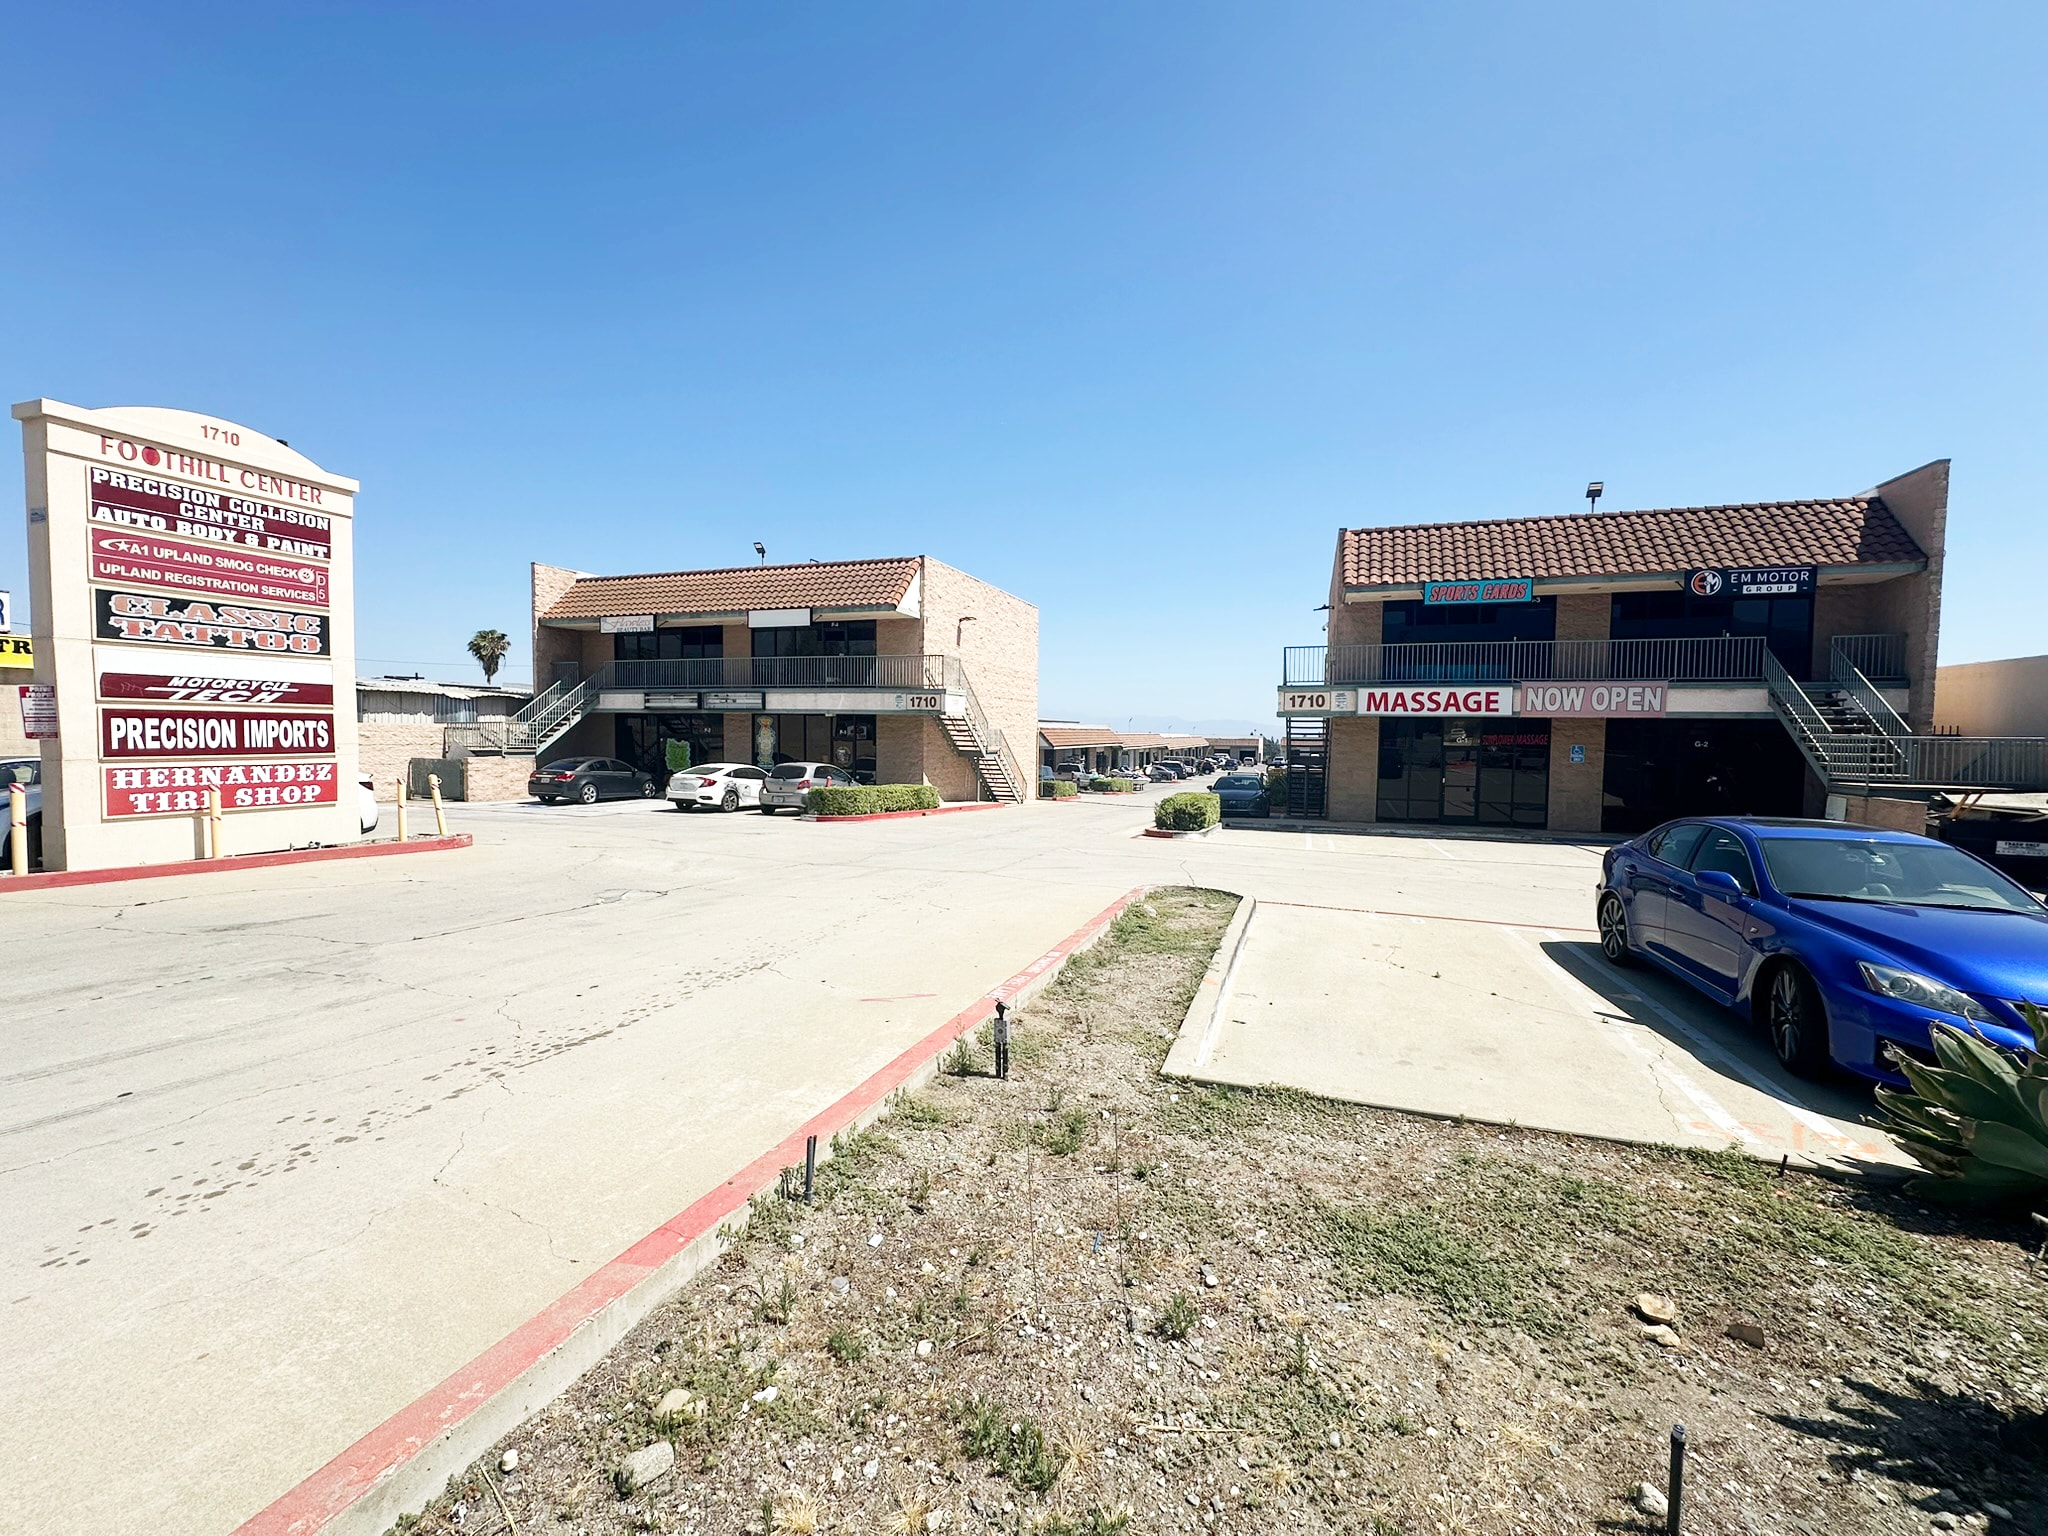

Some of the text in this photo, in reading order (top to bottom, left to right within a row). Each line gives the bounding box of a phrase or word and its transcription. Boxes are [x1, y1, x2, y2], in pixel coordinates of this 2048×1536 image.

[201, 425, 240, 446] 1710
[101, 435, 322, 504] FOOTHILL CENTER
[92, 468, 329, 531] PRECISION COLLISION
[180, 502, 264, 531] CENTER
[95, 505, 328, 558] AUTO BODY & PAINT
[129, 543, 298, 580] A1 UPLAND SMOG CHECK
[99, 562, 316, 601] UPLAND REGISTRATION SERVICES
[318, 575, 326, 586] D
[1731, 571, 1809, 583] EM MOTOR
[318, 589, 326, 600] 5
[1429, 582, 1527, 602] SPORTS CARDS
[1745, 585, 1794, 593] GROUP
[109, 594, 321, 634] CLASSIC
[108, 616, 322, 653] TATTOO
[168, 676, 291, 691] MOTORCYCLE
[169, 690, 283, 703] TECH
[910, 696, 937, 708] 1710
[1289, 694, 1326, 708] 1710
[1366, 691, 1499, 713] MASSAGE
[1526, 688, 1662, 712] NOW OPEN
[110, 717, 329, 750] PRECISION IMPORTS
[112, 763, 333, 790] HERNANDEZ
[234, 785, 321, 806] SHOP
